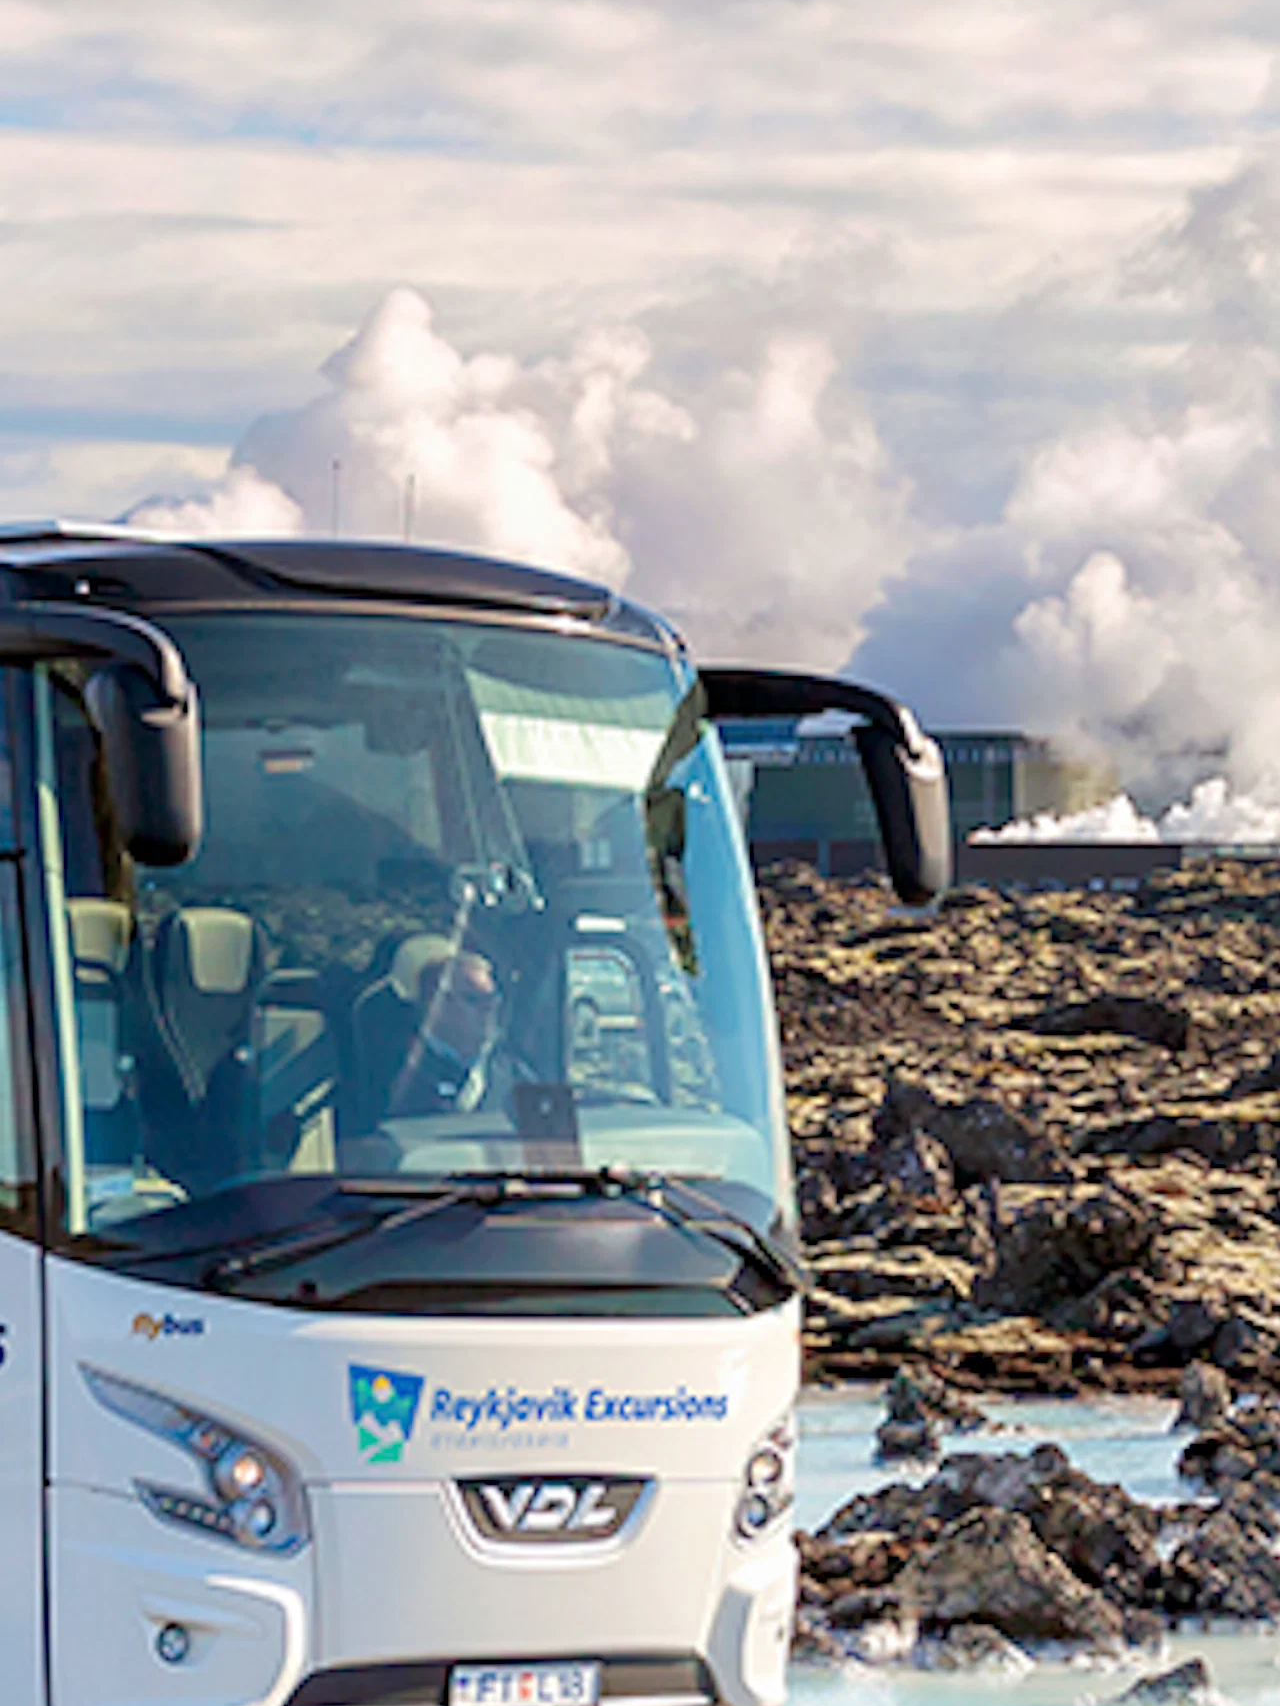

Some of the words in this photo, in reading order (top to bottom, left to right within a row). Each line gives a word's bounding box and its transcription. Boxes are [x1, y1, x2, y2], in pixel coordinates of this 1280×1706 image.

[132, 1312, 204, 1340] flybus
[430, 1386, 578, 1430] Reykjavik
[584, 1385, 728, 1421] Excursions
[478, 1484, 617, 1531] VDL
